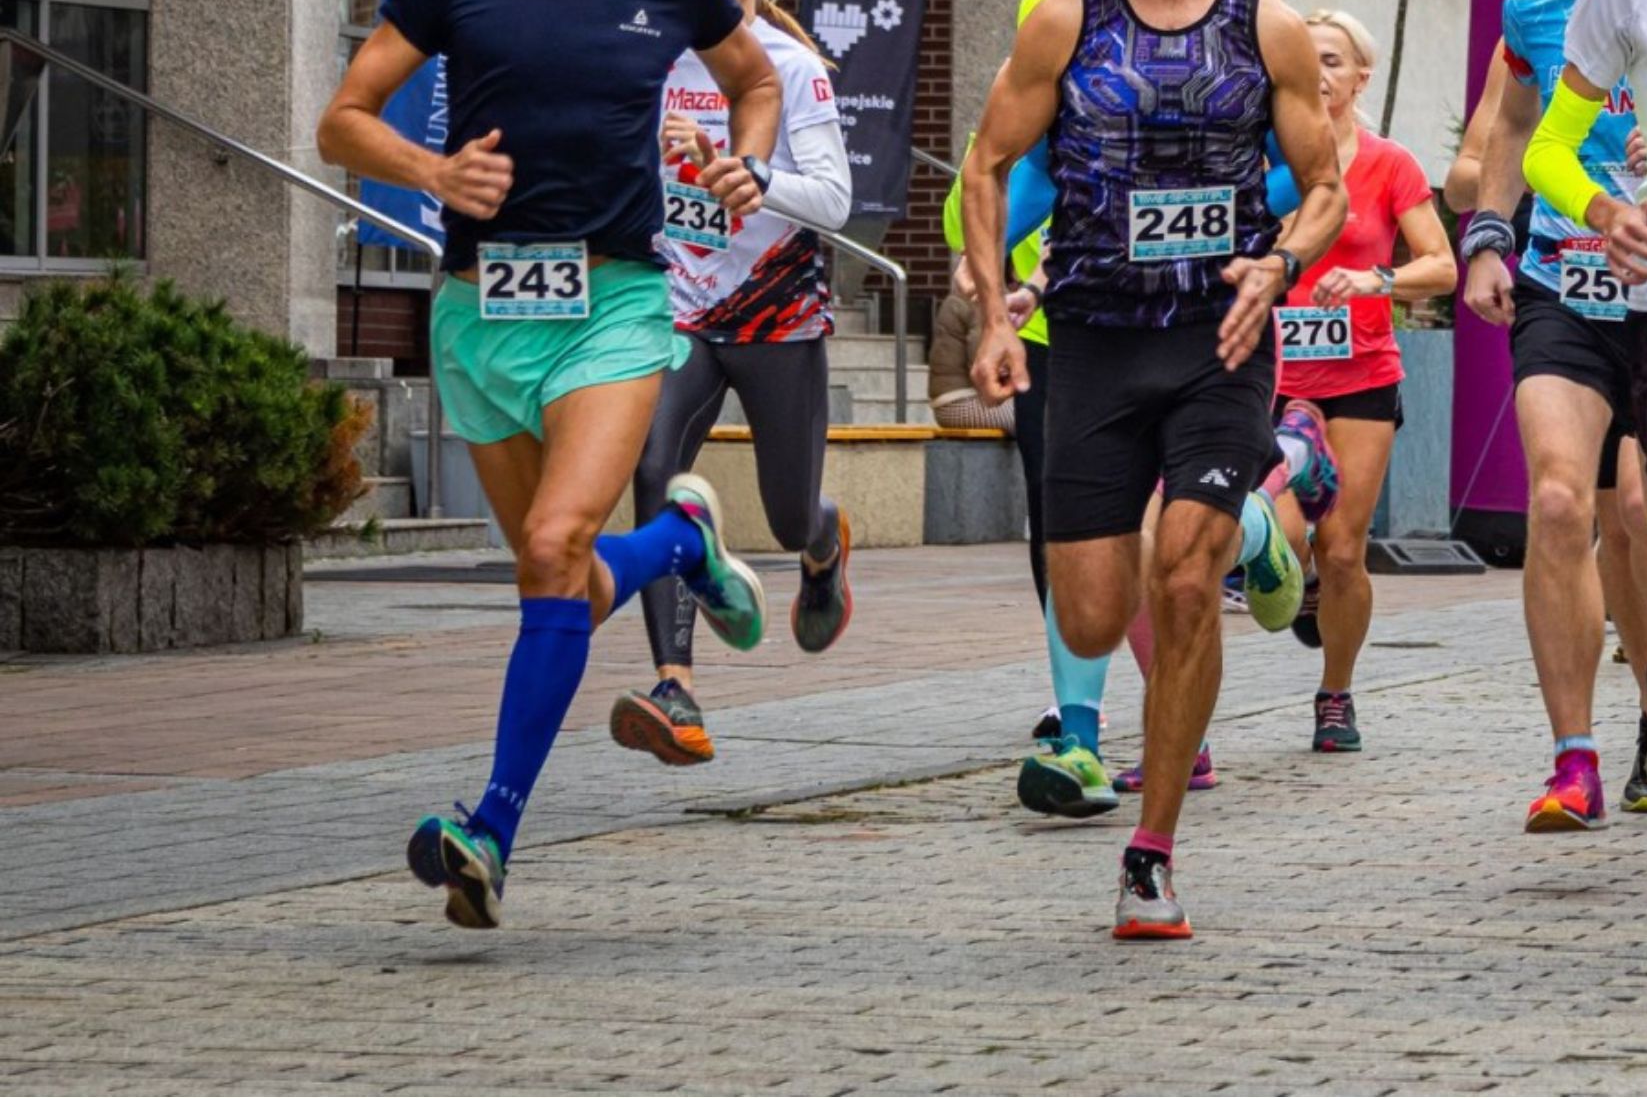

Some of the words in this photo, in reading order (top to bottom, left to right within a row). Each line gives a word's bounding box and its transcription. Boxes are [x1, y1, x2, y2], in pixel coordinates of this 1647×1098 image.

[665, 196, 728, 237] 234
[1135, 203, 1230, 242] 248
[485, 262, 583, 299] 243
[1281, 318, 1348, 347] 270
